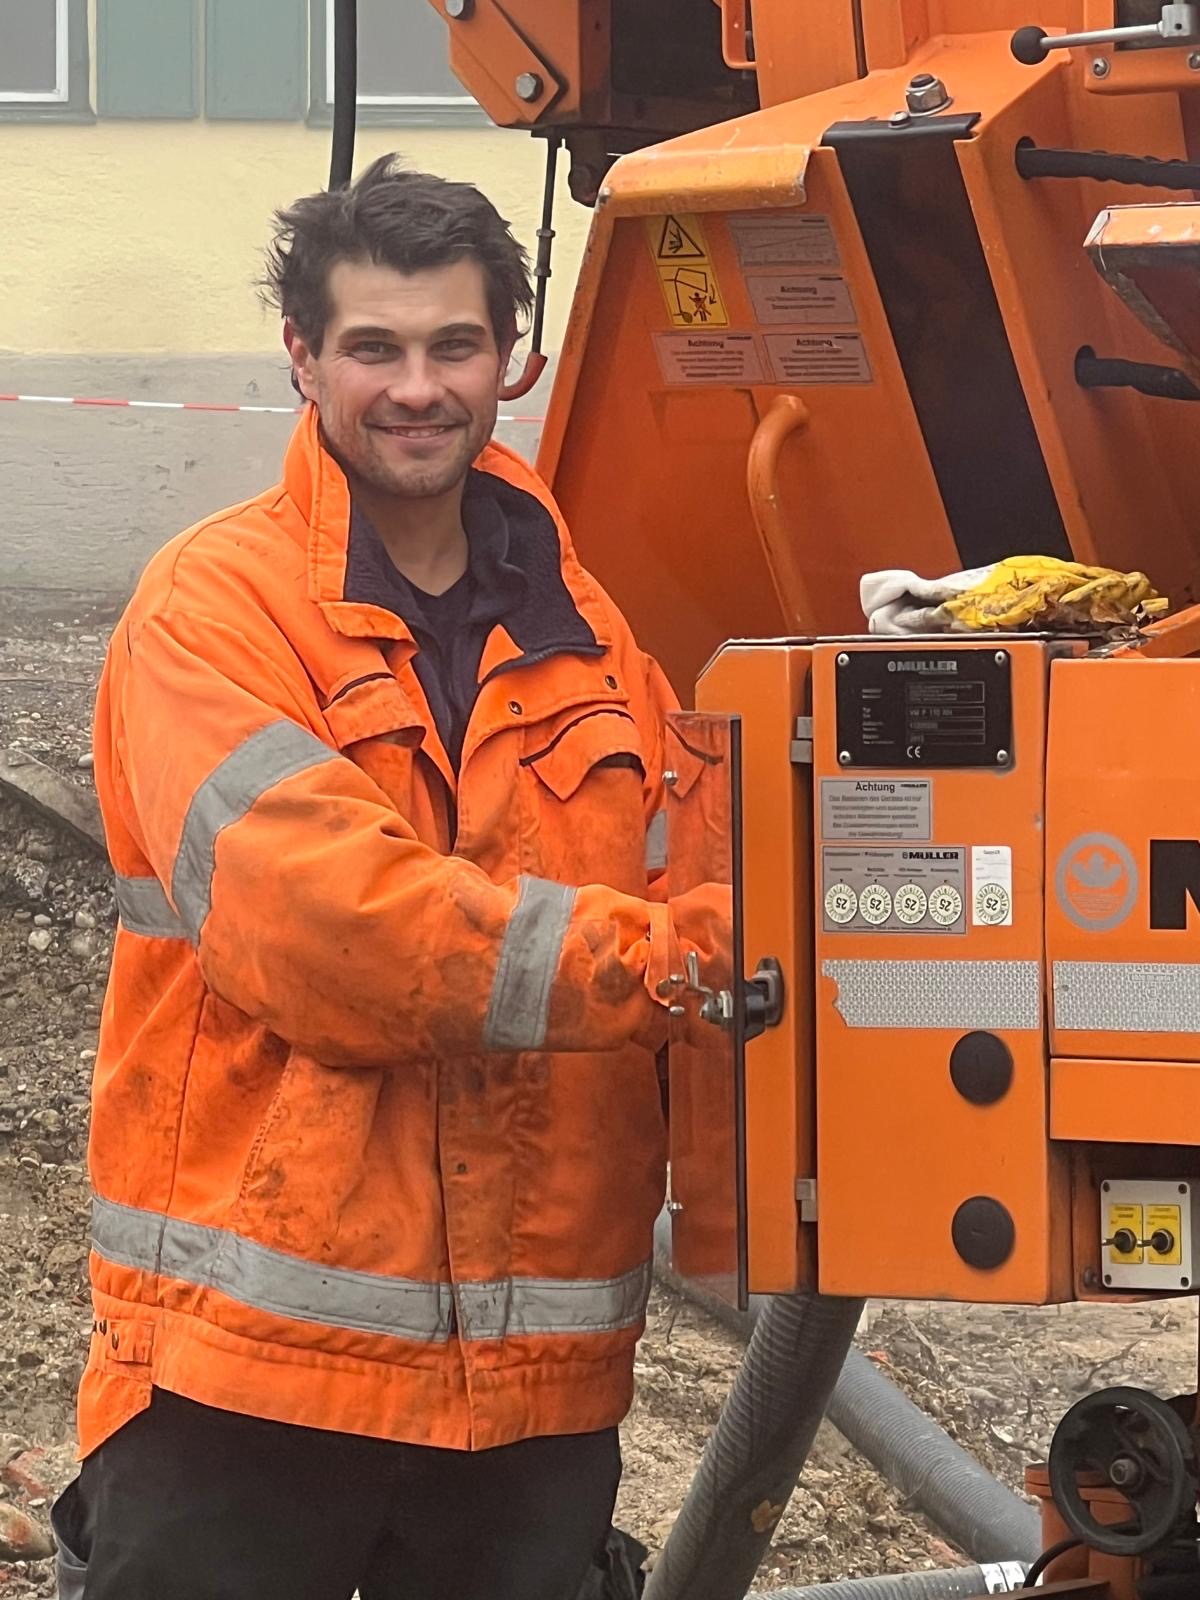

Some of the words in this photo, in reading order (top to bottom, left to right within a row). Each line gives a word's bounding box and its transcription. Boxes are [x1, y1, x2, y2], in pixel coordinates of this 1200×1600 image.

[855, 781, 896, 794] Achtung
[835, 898, 848, 910] 25
[869, 898, 882, 910] 25
[904, 898, 917, 910] 25
[939, 898, 951, 911] 25
[986, 898, 998, 910] 25
